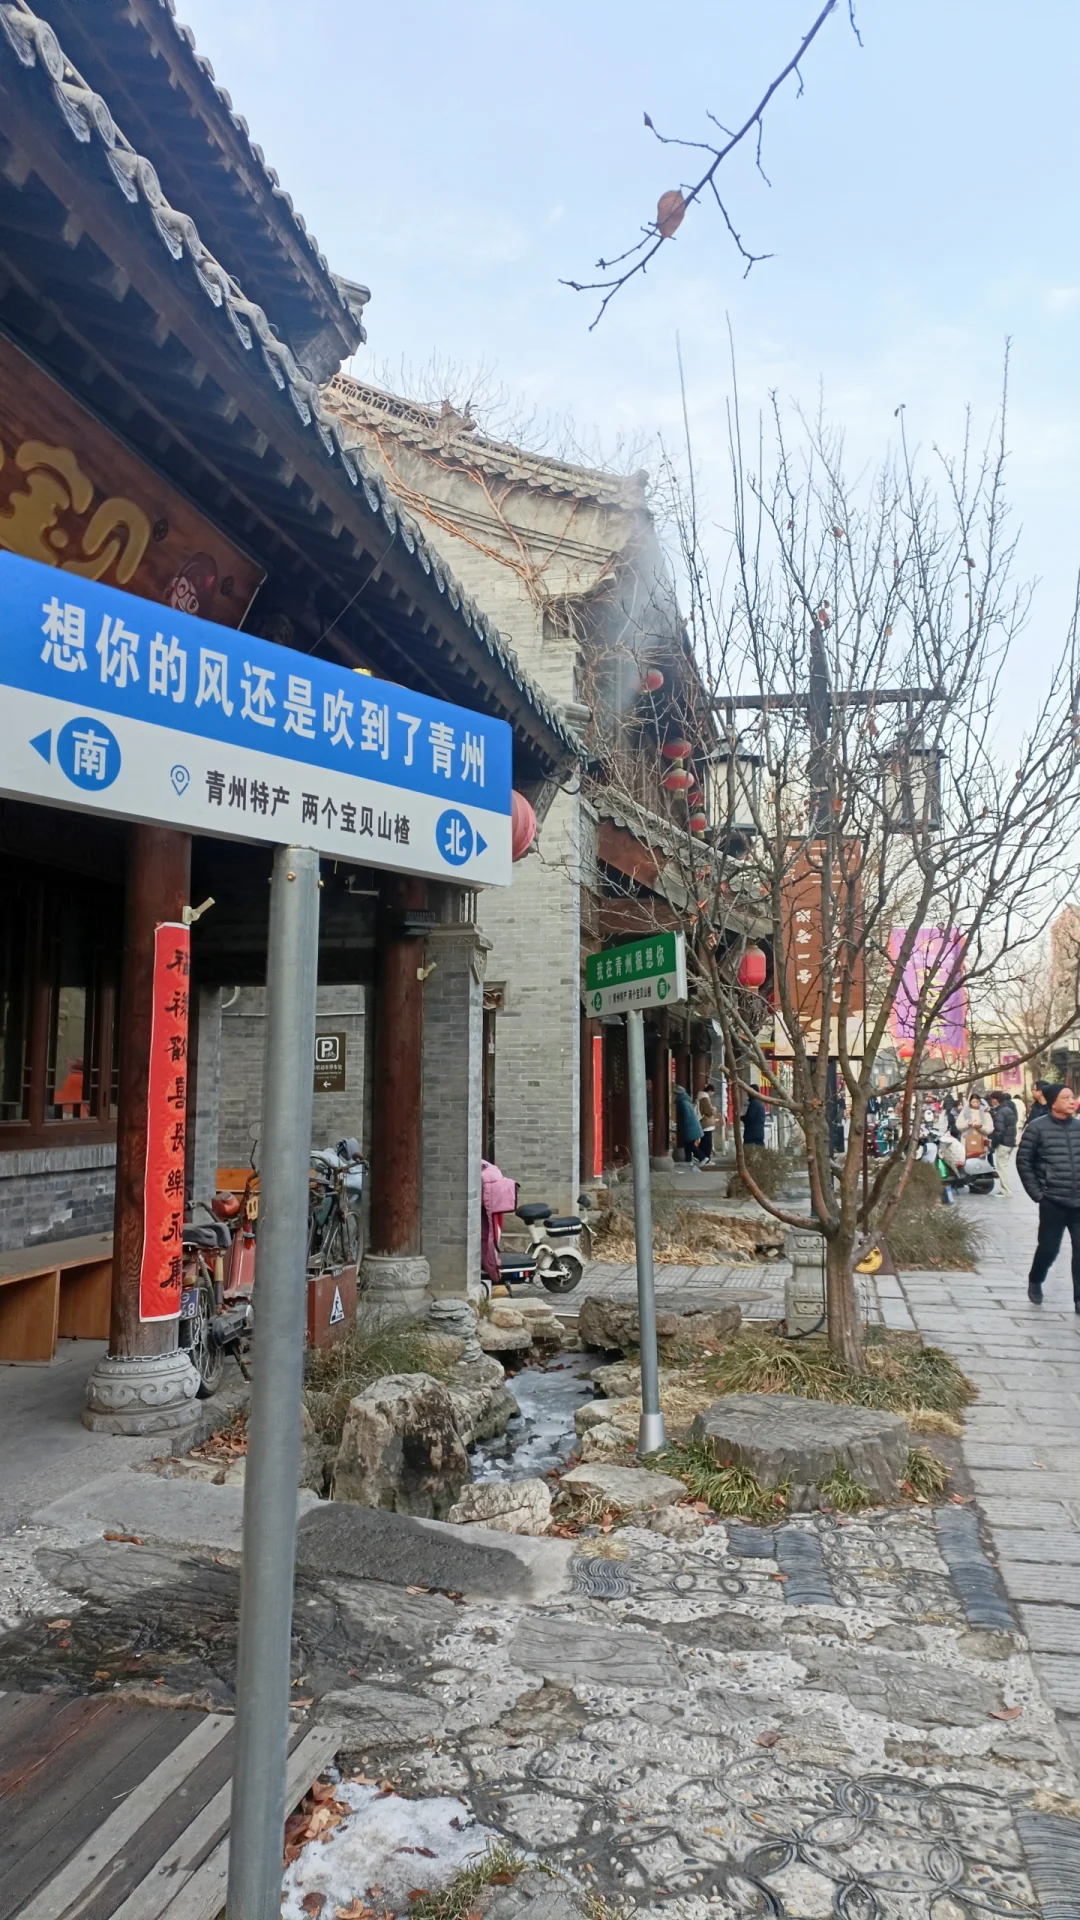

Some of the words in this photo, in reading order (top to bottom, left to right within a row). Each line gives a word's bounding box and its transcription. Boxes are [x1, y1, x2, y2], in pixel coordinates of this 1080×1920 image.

[40, 596, 486, 788] 想你的风还是吹到了青州
[72, 729, 110, 780] 南
[205, 770, 291, 817] 青州特产
[301, 791, 411, 846] 两个宝贝山楂
[445, 818, 467, 858] 北
[596, 945, 665, 980] 我在青州很想你
[321, 1040, 334, 1059] P
